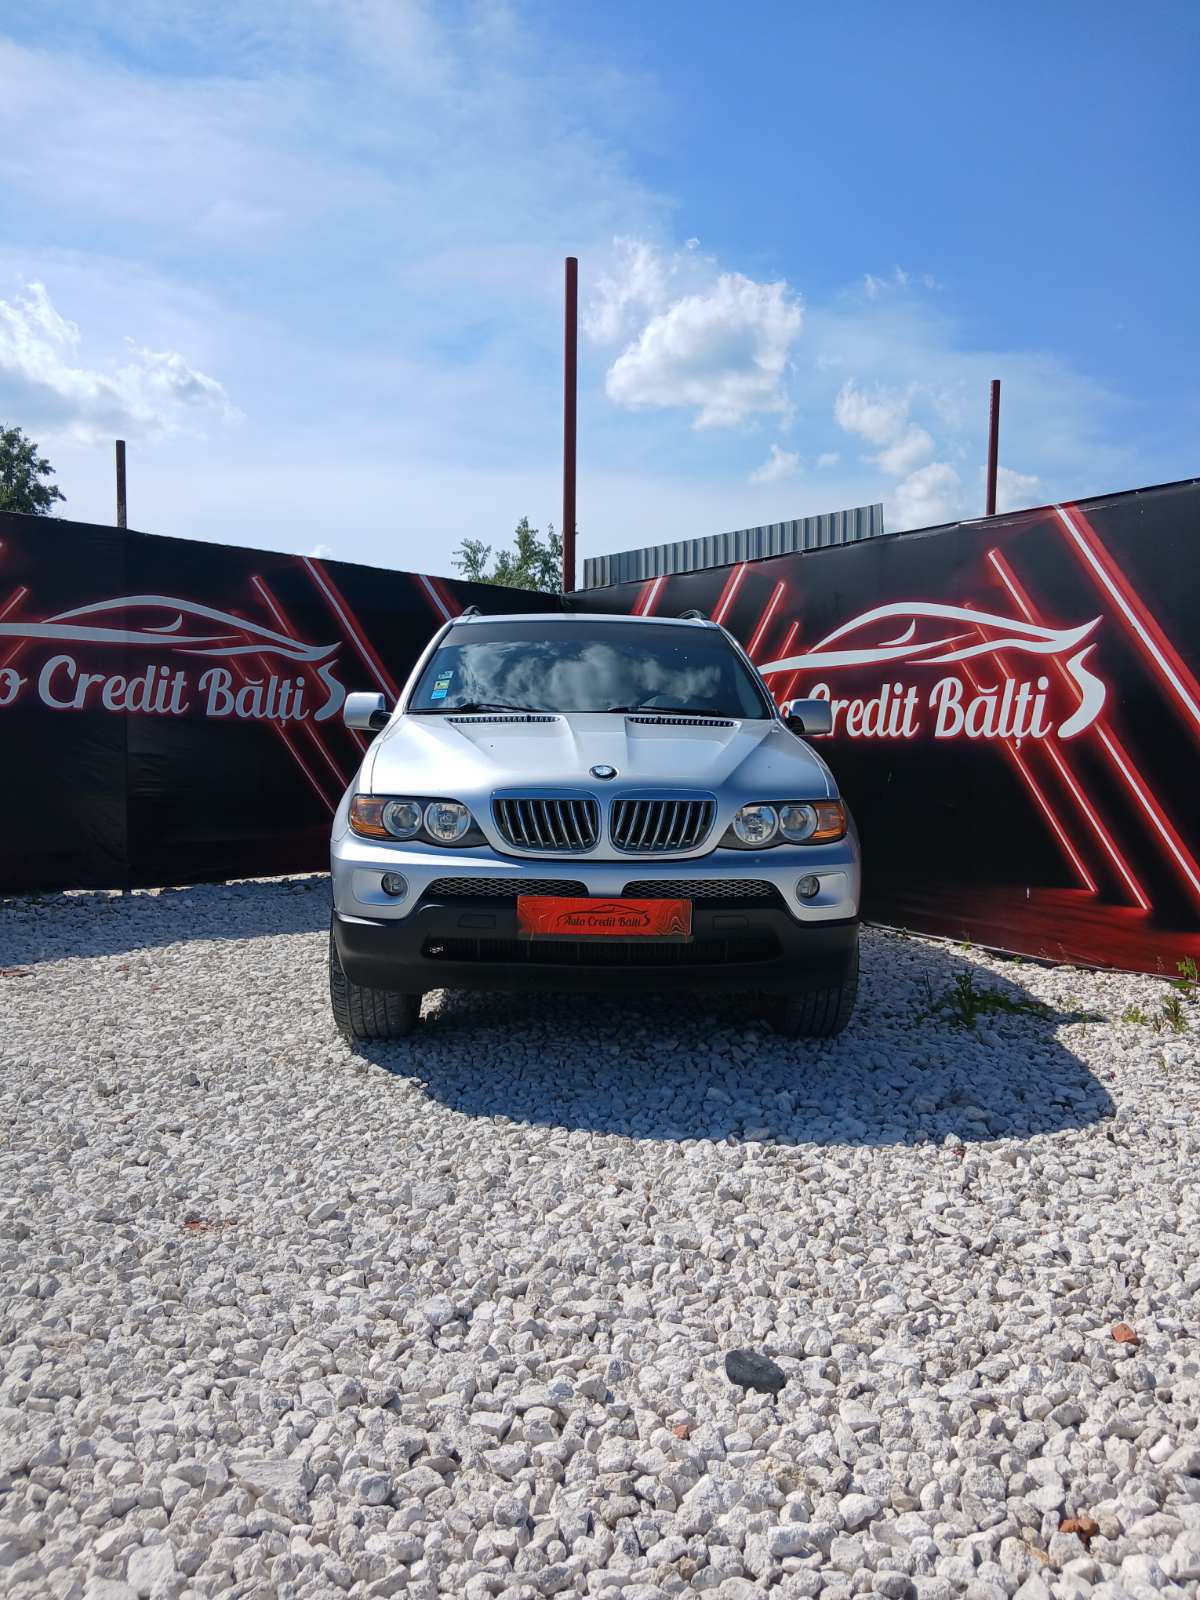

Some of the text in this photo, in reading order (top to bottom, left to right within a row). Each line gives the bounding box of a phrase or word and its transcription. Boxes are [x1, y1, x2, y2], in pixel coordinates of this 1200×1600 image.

[38, 655, 190, 714] Credit
[564, 915, 585, 926] Auto
[587, 915, 616, 927] Credit
